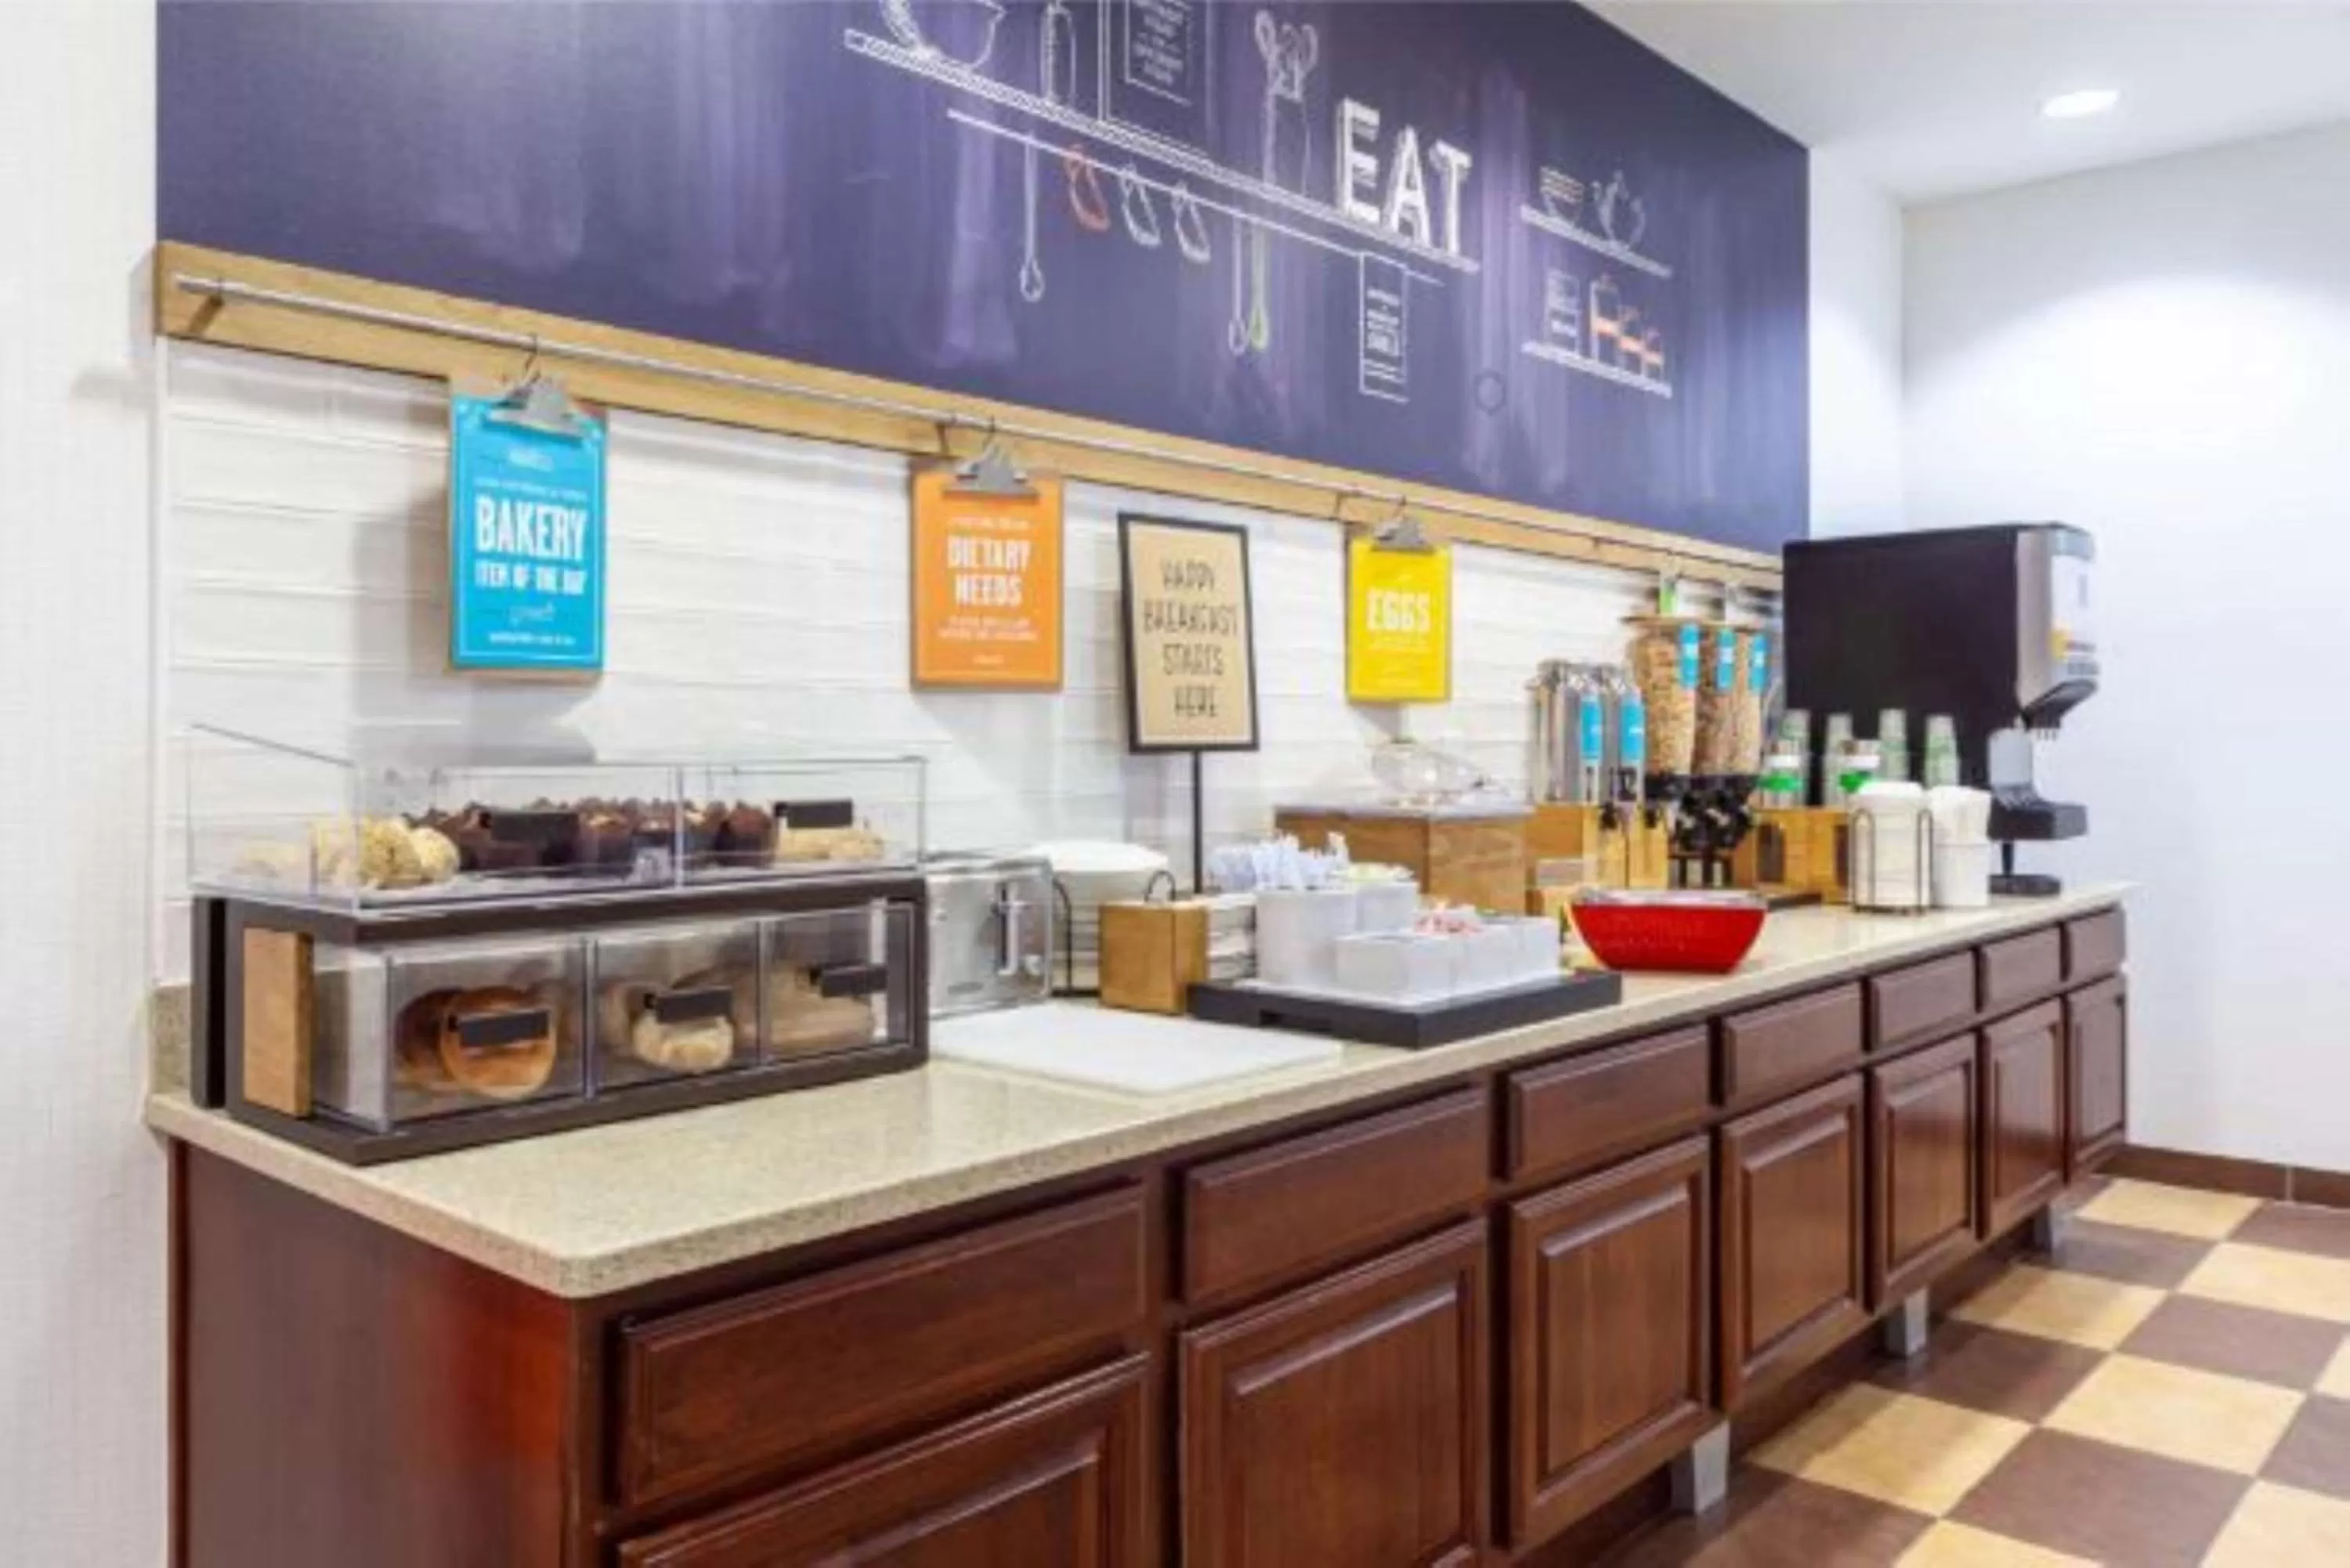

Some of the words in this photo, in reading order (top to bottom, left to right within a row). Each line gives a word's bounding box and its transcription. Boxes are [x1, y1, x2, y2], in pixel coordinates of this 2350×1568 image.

[1335, 96, 1473, 255] EAT
[475, 495, 588, 559] BAKERY
[947, 536, 1031, 571] DIETARY
[955, 574, 1023, 606] NEEDS
[1161, 558, 1214, 589] HAPPY
[1144, 598, 1238, 635] BREAKFAST
[1366, 588, 1430, 632] EGGS
[1162, 643, 1224, 675] STARTS
[1174, 686, 1219, 717] HERE
